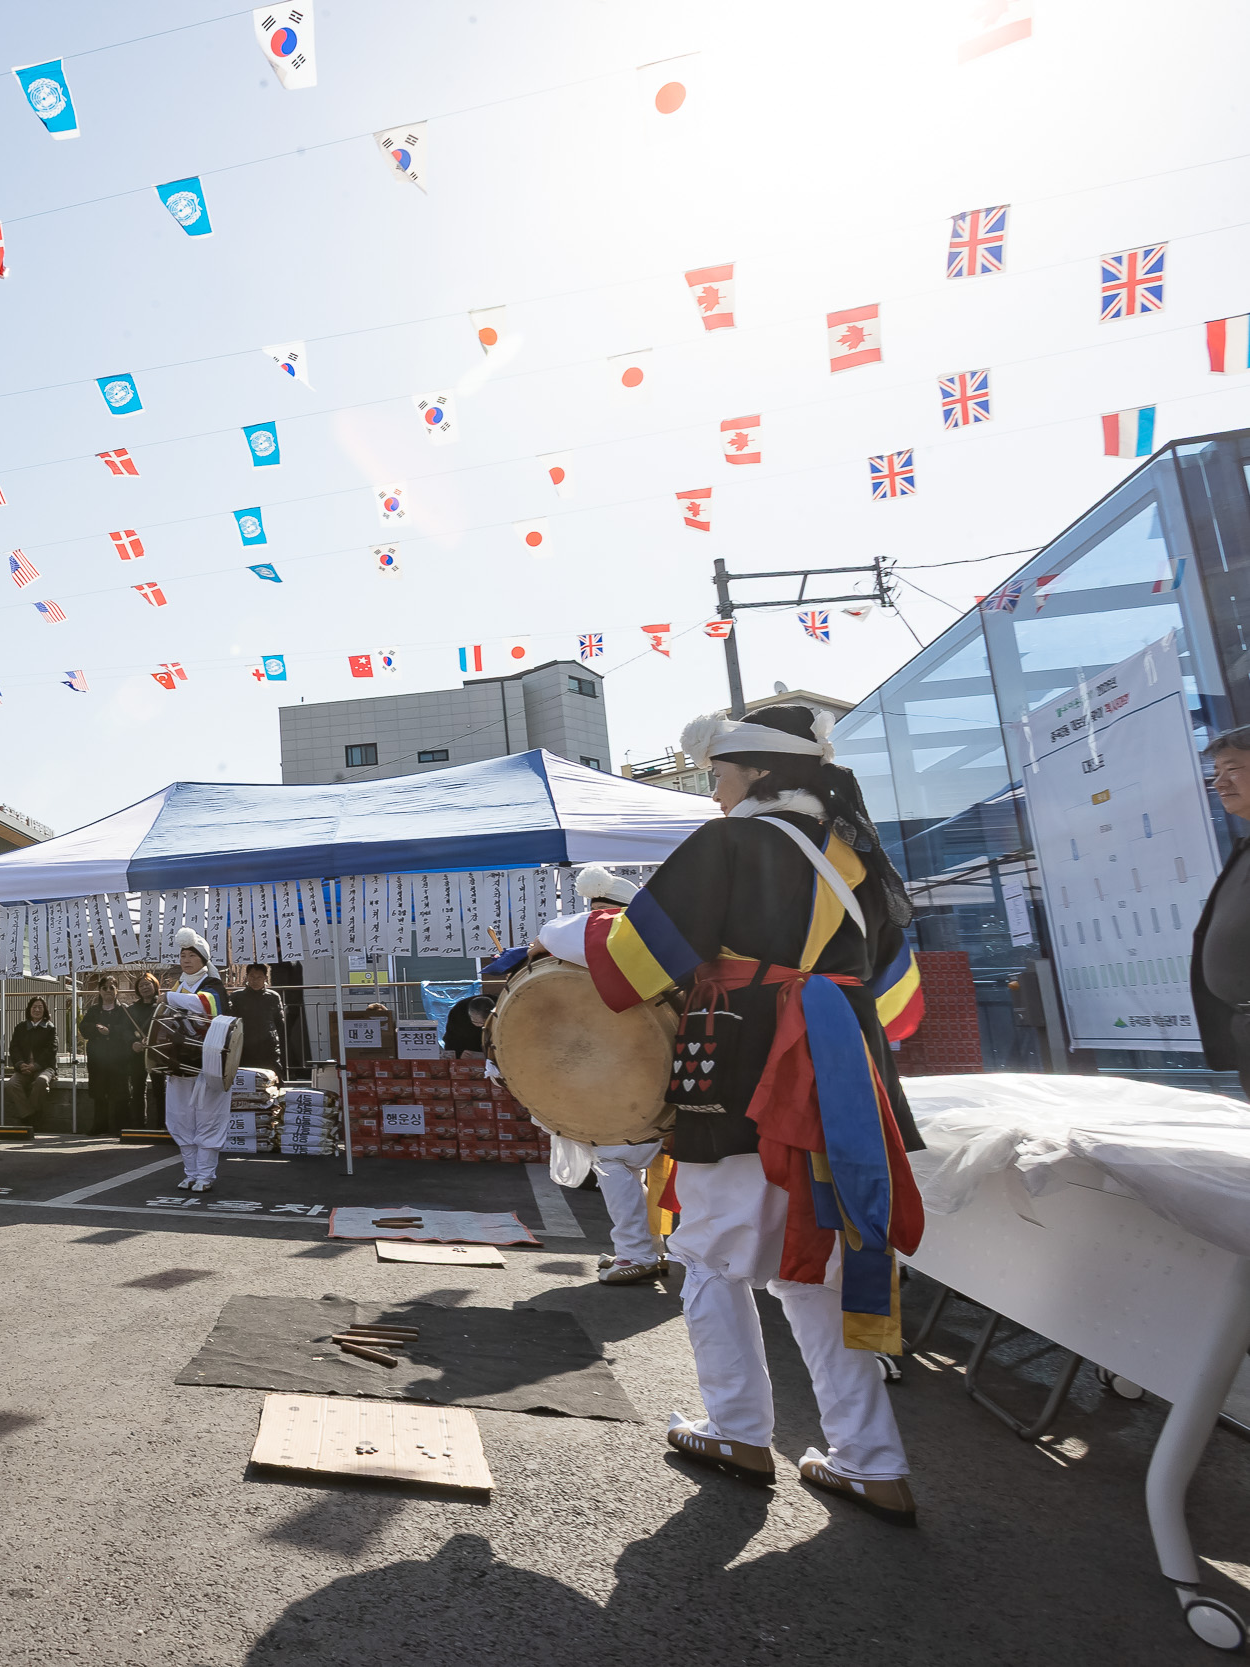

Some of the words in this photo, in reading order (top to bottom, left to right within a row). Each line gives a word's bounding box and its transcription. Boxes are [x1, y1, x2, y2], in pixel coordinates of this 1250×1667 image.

[400, 1032, 437, 1046] 추첨함
[386, 1113, 422, 1127] 행운상
[145, 1195, 329, 1217] 관용차
